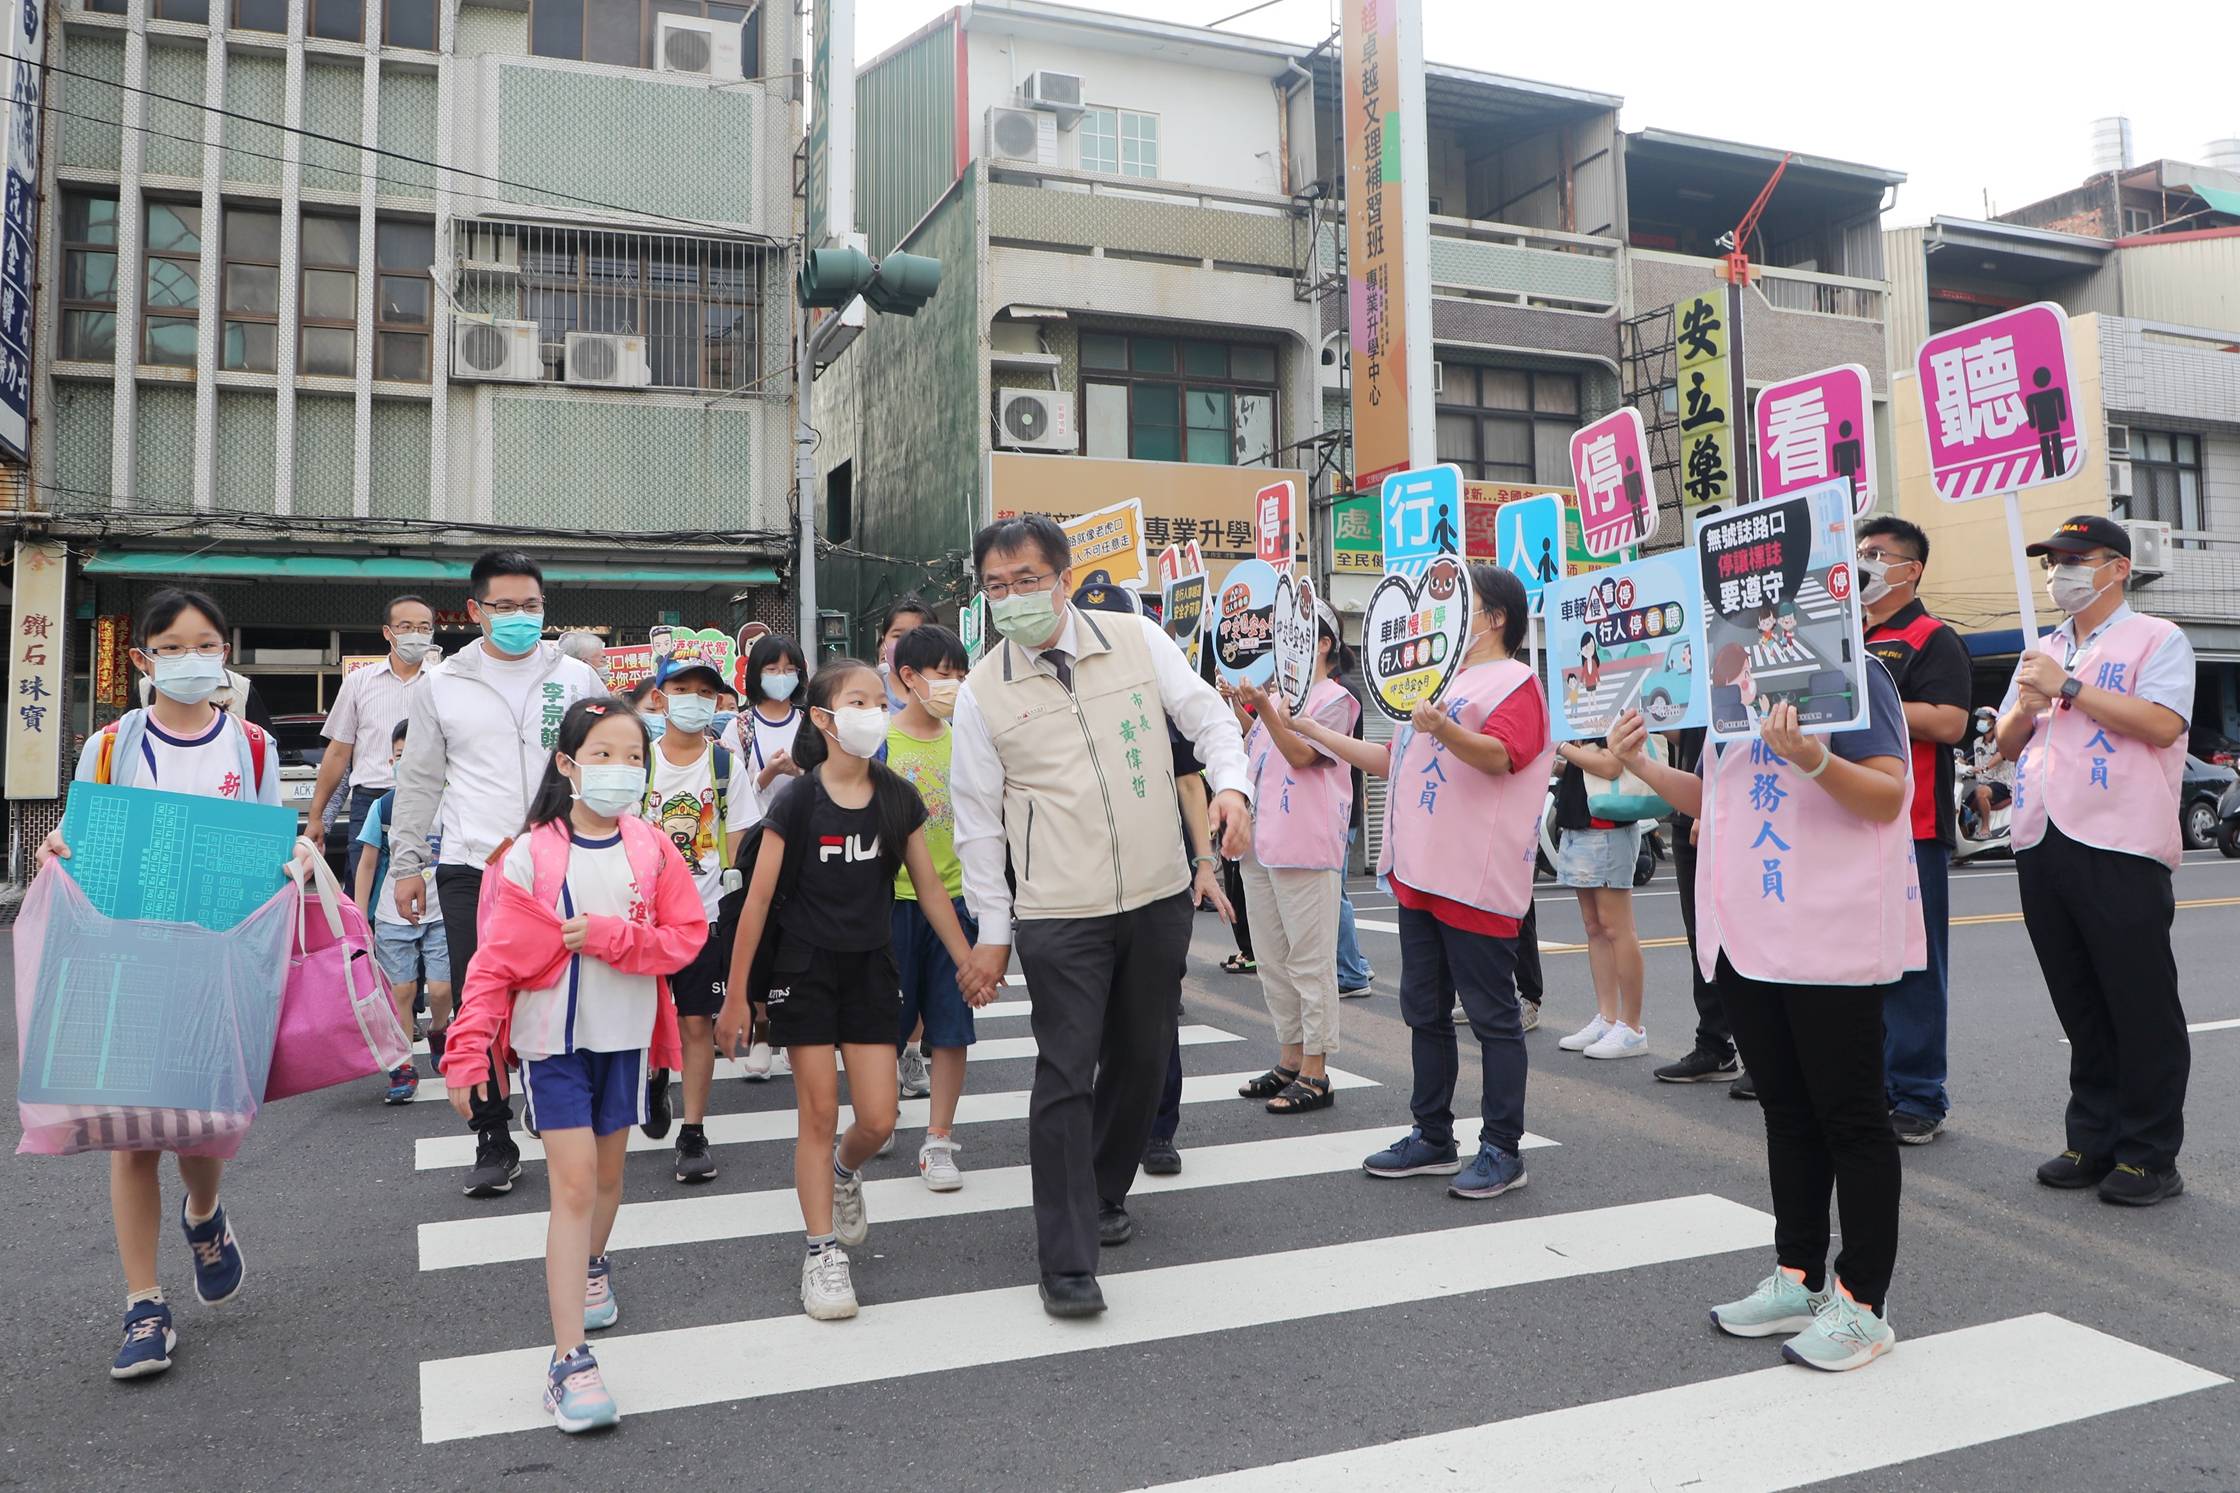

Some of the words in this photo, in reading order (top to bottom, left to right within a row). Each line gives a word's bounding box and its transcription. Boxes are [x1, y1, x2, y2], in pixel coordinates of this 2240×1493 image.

[1360, 0, 1385, 259] 超卓越文理補習班
[1365, 268, 1382, 407] 專業升學中心
[1677, 298, 1728, 519] 安立藥
[1930, 333, 2029, 449] 聽
[1767, 388, 1829, 486] 看
[1579, 434, 1625, 518] 停
[1144, 516, 1304, 550] 專業升學
[1258, 496, 1281, 555] 停
[1388, 481, 1435, 548] 行
[1508, 512, 1541, 580] 人
[1706, 510, 1787, 553] 無號誌路口
[1717, 541, 1785, 579] 停讓標誌
[1832, 572, 1849, 593] 停
[1560, 583, 1633, 622] 車輛慢看停
[1719, 570, 1785, 615] 要遵守
[1380, 605, 1447, 644] 車輛慢看停
[1380, 637, 1447, 673] 行人停看聽
[1599, 605, 1681, 644] 行人停看聽
[19, 612, 54, 733] 鑽石珠寶
[1130, 692, 1152, 732] 市長
[2085, 662, 2127, 791] 服人員
[218, 771, 241, 798] 新
[1119, 719, 1147, 798] 黃偉哲
[1749, 738, 1792, 903] 服務人員
